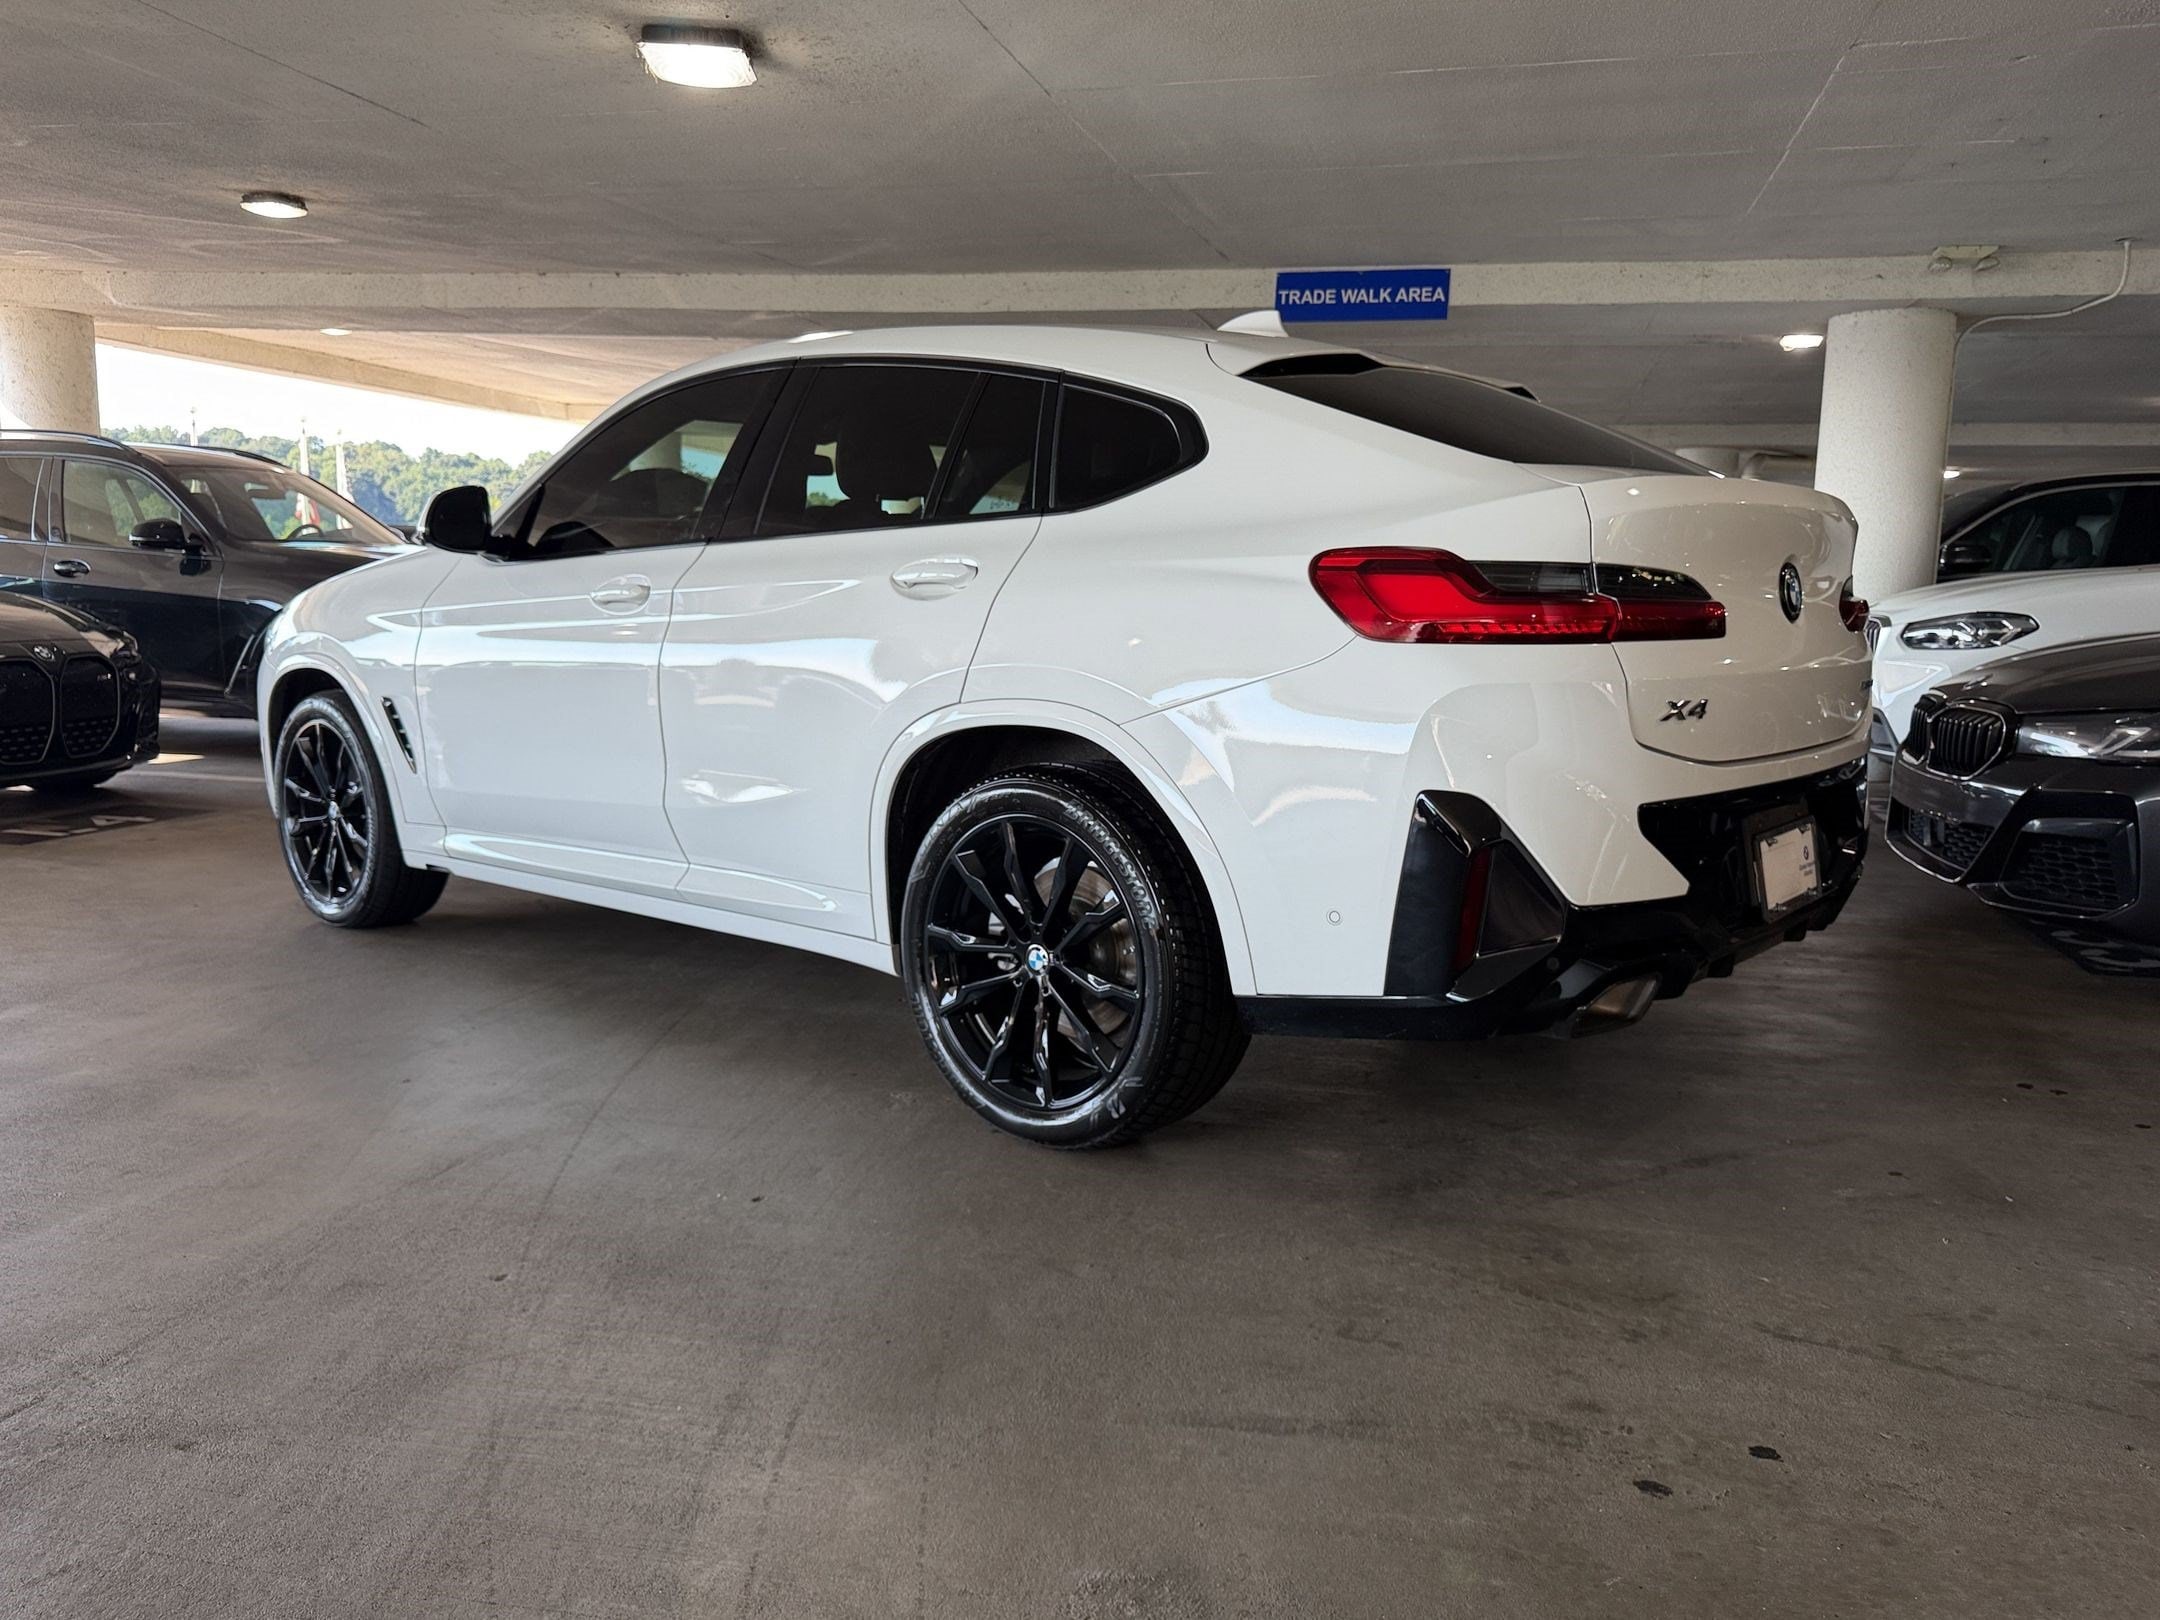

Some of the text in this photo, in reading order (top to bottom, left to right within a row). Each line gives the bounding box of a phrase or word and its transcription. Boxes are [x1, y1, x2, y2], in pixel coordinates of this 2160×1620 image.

[1279, 286, 1445, 305] TRADE WALK AREA
[1660, 699, 1708, 721] X4
